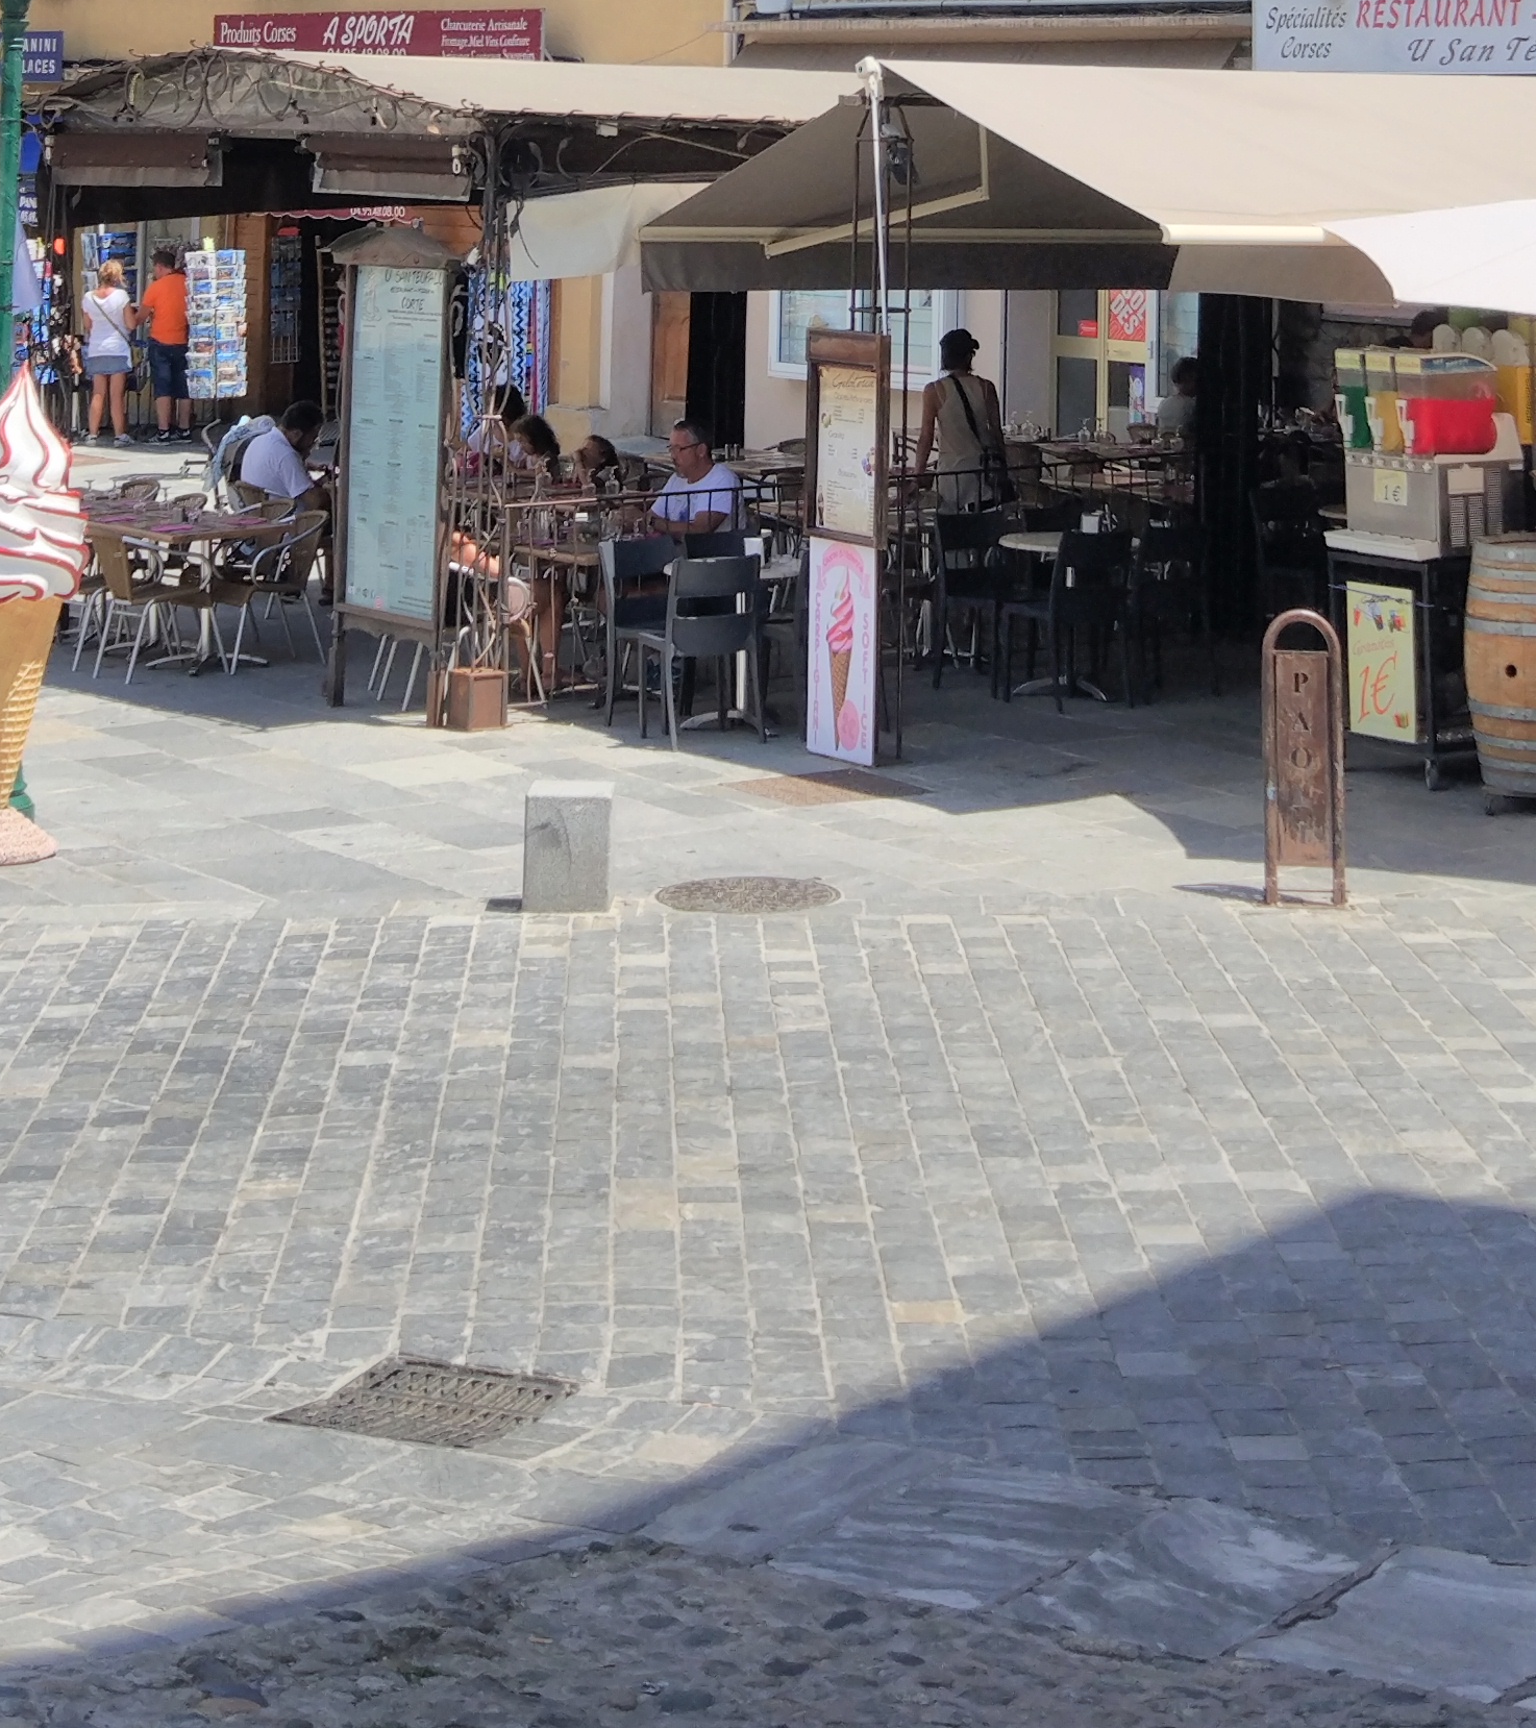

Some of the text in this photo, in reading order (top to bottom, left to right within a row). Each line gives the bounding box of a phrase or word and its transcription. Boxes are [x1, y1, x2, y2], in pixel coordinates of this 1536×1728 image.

[323, 14, 416, 46] A SPORTA
[488, 17, 529, 31] Artisanale
[1265, 4, 1348, 34] Spécialités
[219, 20, 298, 44] Produits Corses
[22, 37, 57, 52] ANINI
[1280, 35, 1332, 59] Corses
[1439, 38, 1495, 66] San
[22, 59, 56, 74] LACES
